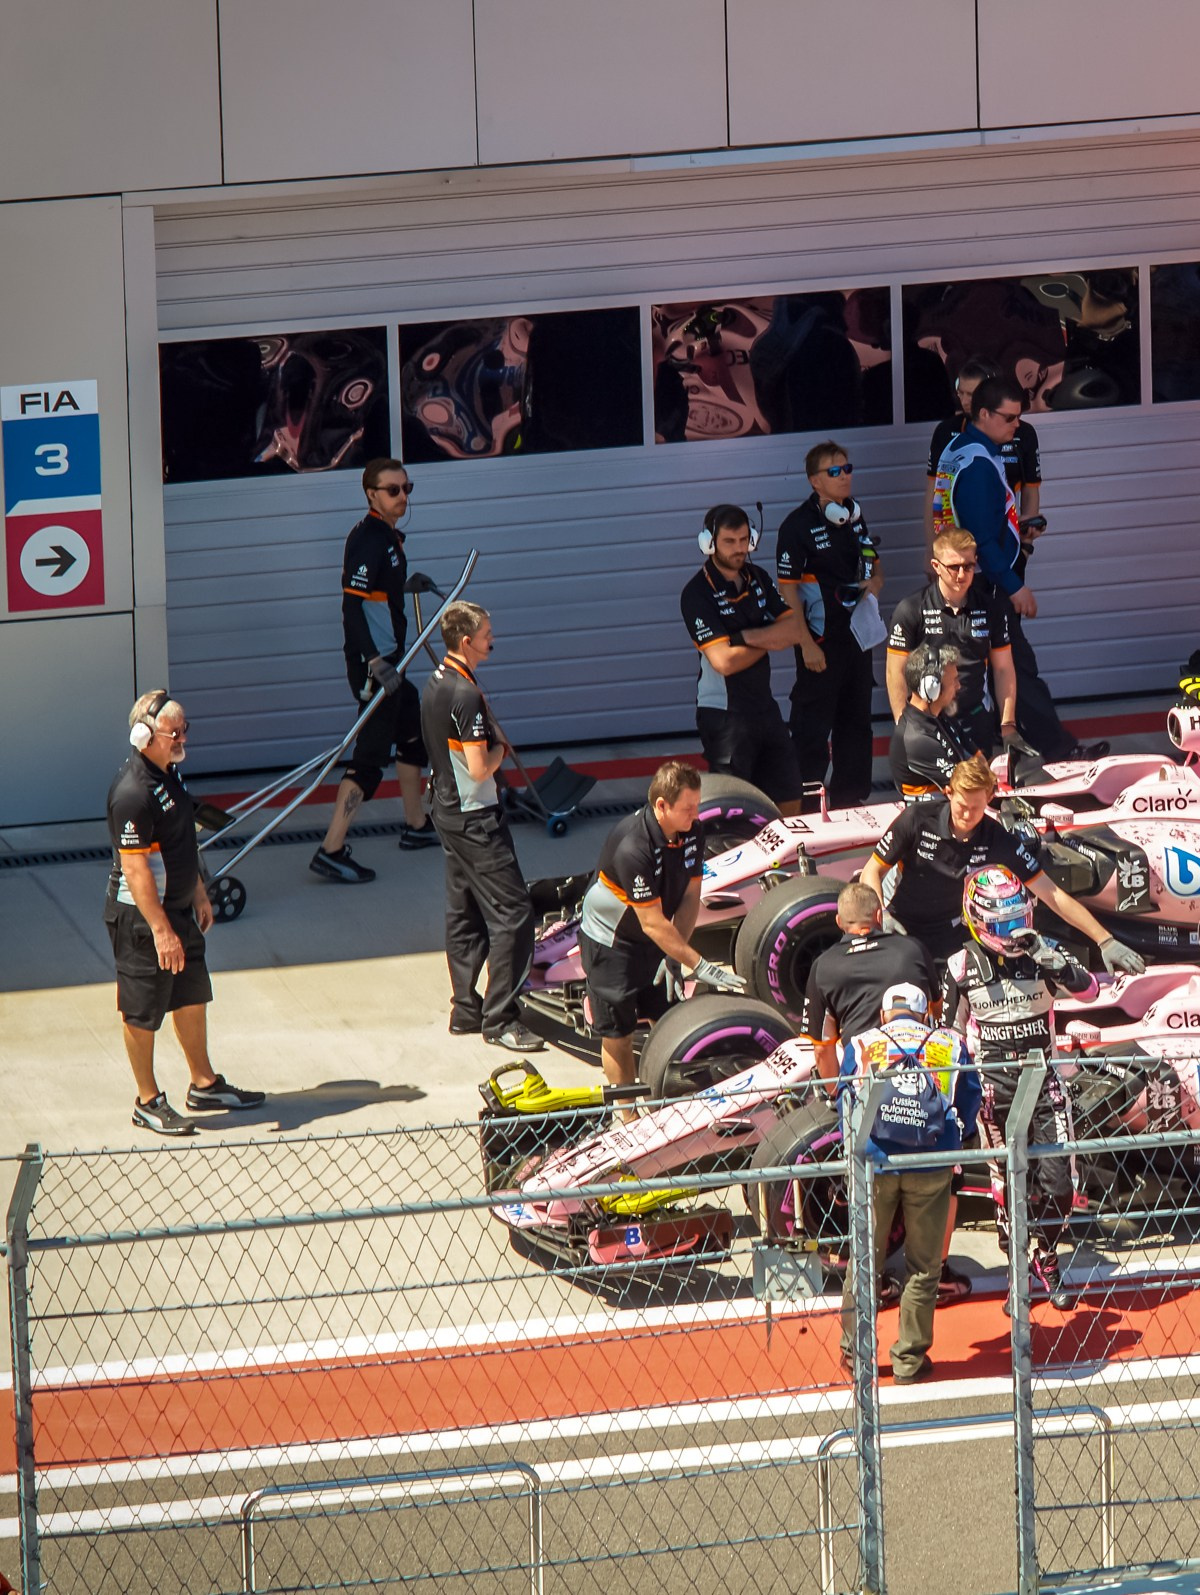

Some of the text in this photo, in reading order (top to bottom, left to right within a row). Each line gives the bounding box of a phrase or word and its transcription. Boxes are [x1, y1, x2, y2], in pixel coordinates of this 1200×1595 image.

[20, 390, 80, 415] FIA
[34, 443, 69, 476] 3
[815, 541, 832, 550] NEC
[924, 627, 943, 635] NEC
[1132, 792, 1191, 813] Claro
[757, 826, 786, 852] HYPE
[916, 848, 935, 861] NEC
[973, 894, 992, 908] NEC
[767, 931, 788, 1005] ZERO
[980, 1018, 1049, 1041] KINGFISHER
[769, 1047, 798, 1076] HYPE
[880, 1104, 929, 1120] automobile
[892, 1097, 921, 1109] russian
[881, 1112, 926, 1129] federation
